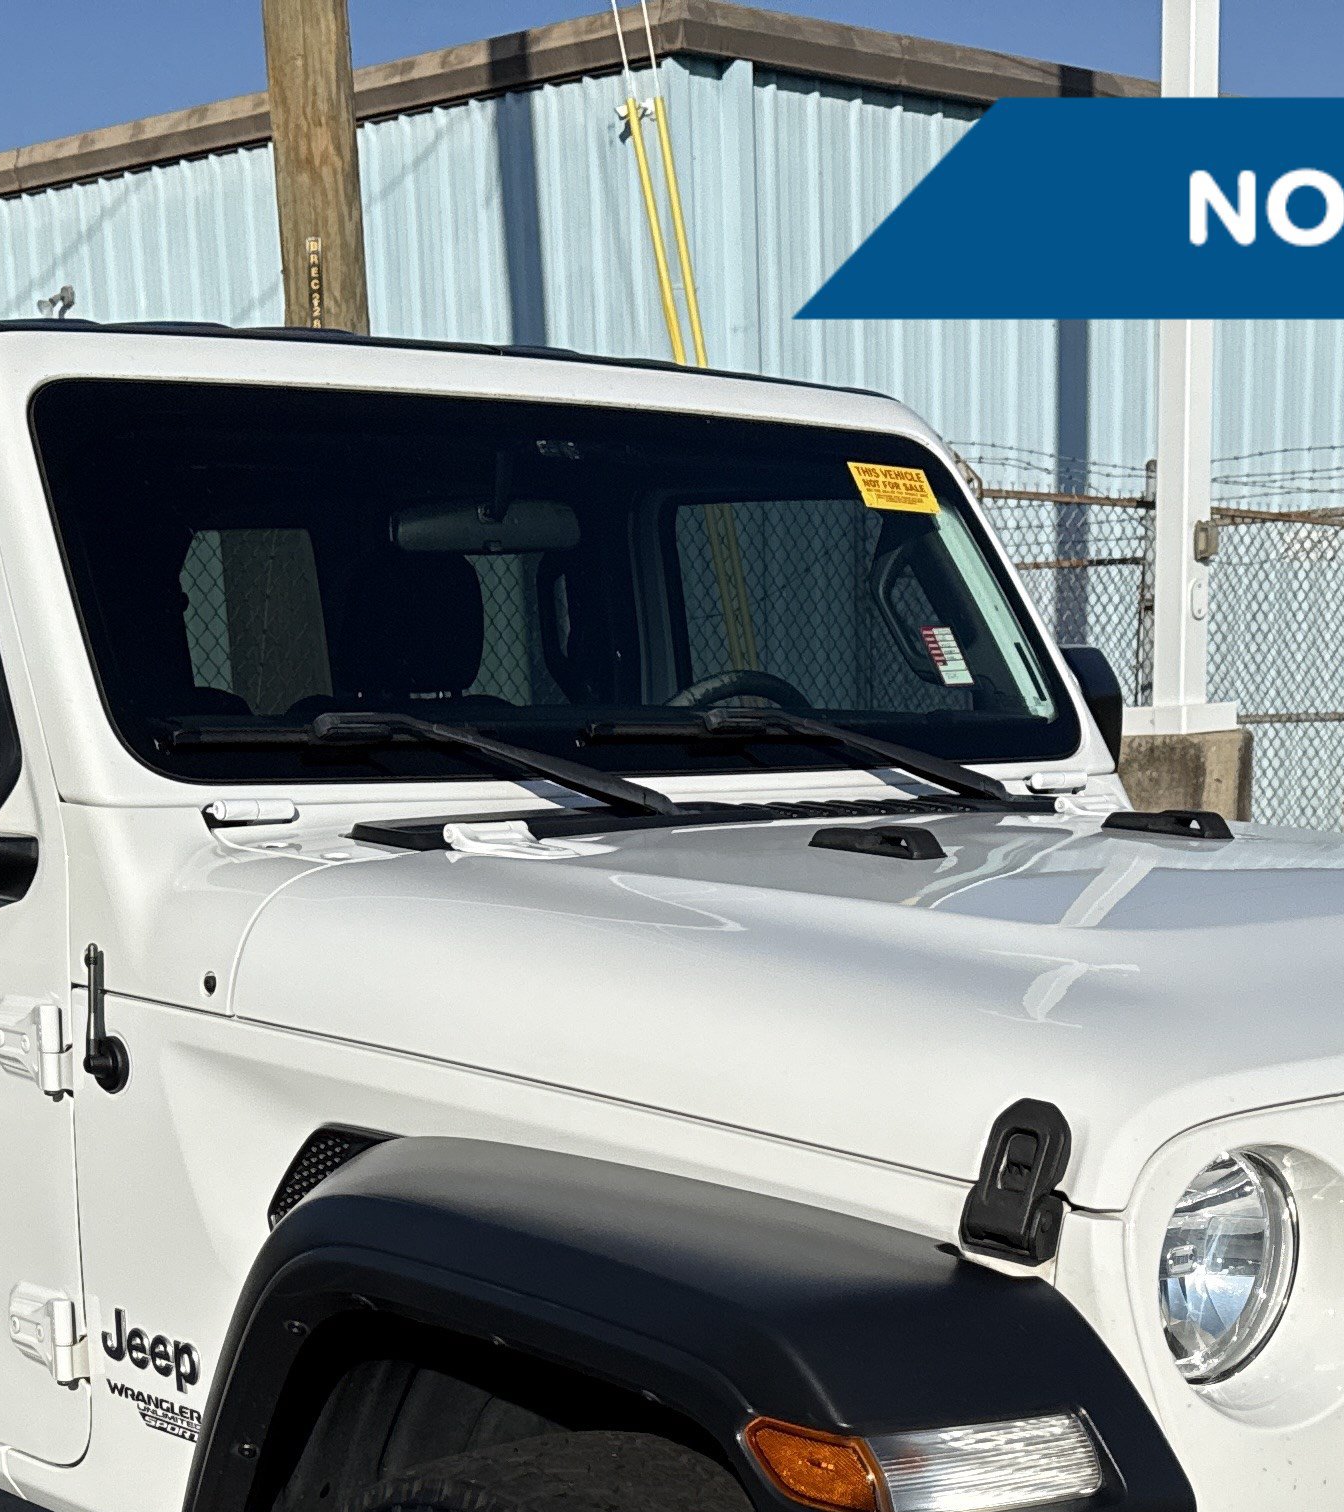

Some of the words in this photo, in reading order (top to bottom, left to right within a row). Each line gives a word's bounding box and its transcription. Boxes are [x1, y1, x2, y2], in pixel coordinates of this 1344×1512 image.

[854, 466, 880, 479] THIS
[879, 468, 925, 483] VEHICLE
[861, 479, 881, 489] NOT
[882, 481, 902, 491] FOR
[903, 483, 926, 493] SALE
[101, 1307, 201, 1395] Jeep
[106, 1378, 202, 1424] WRANGLER
